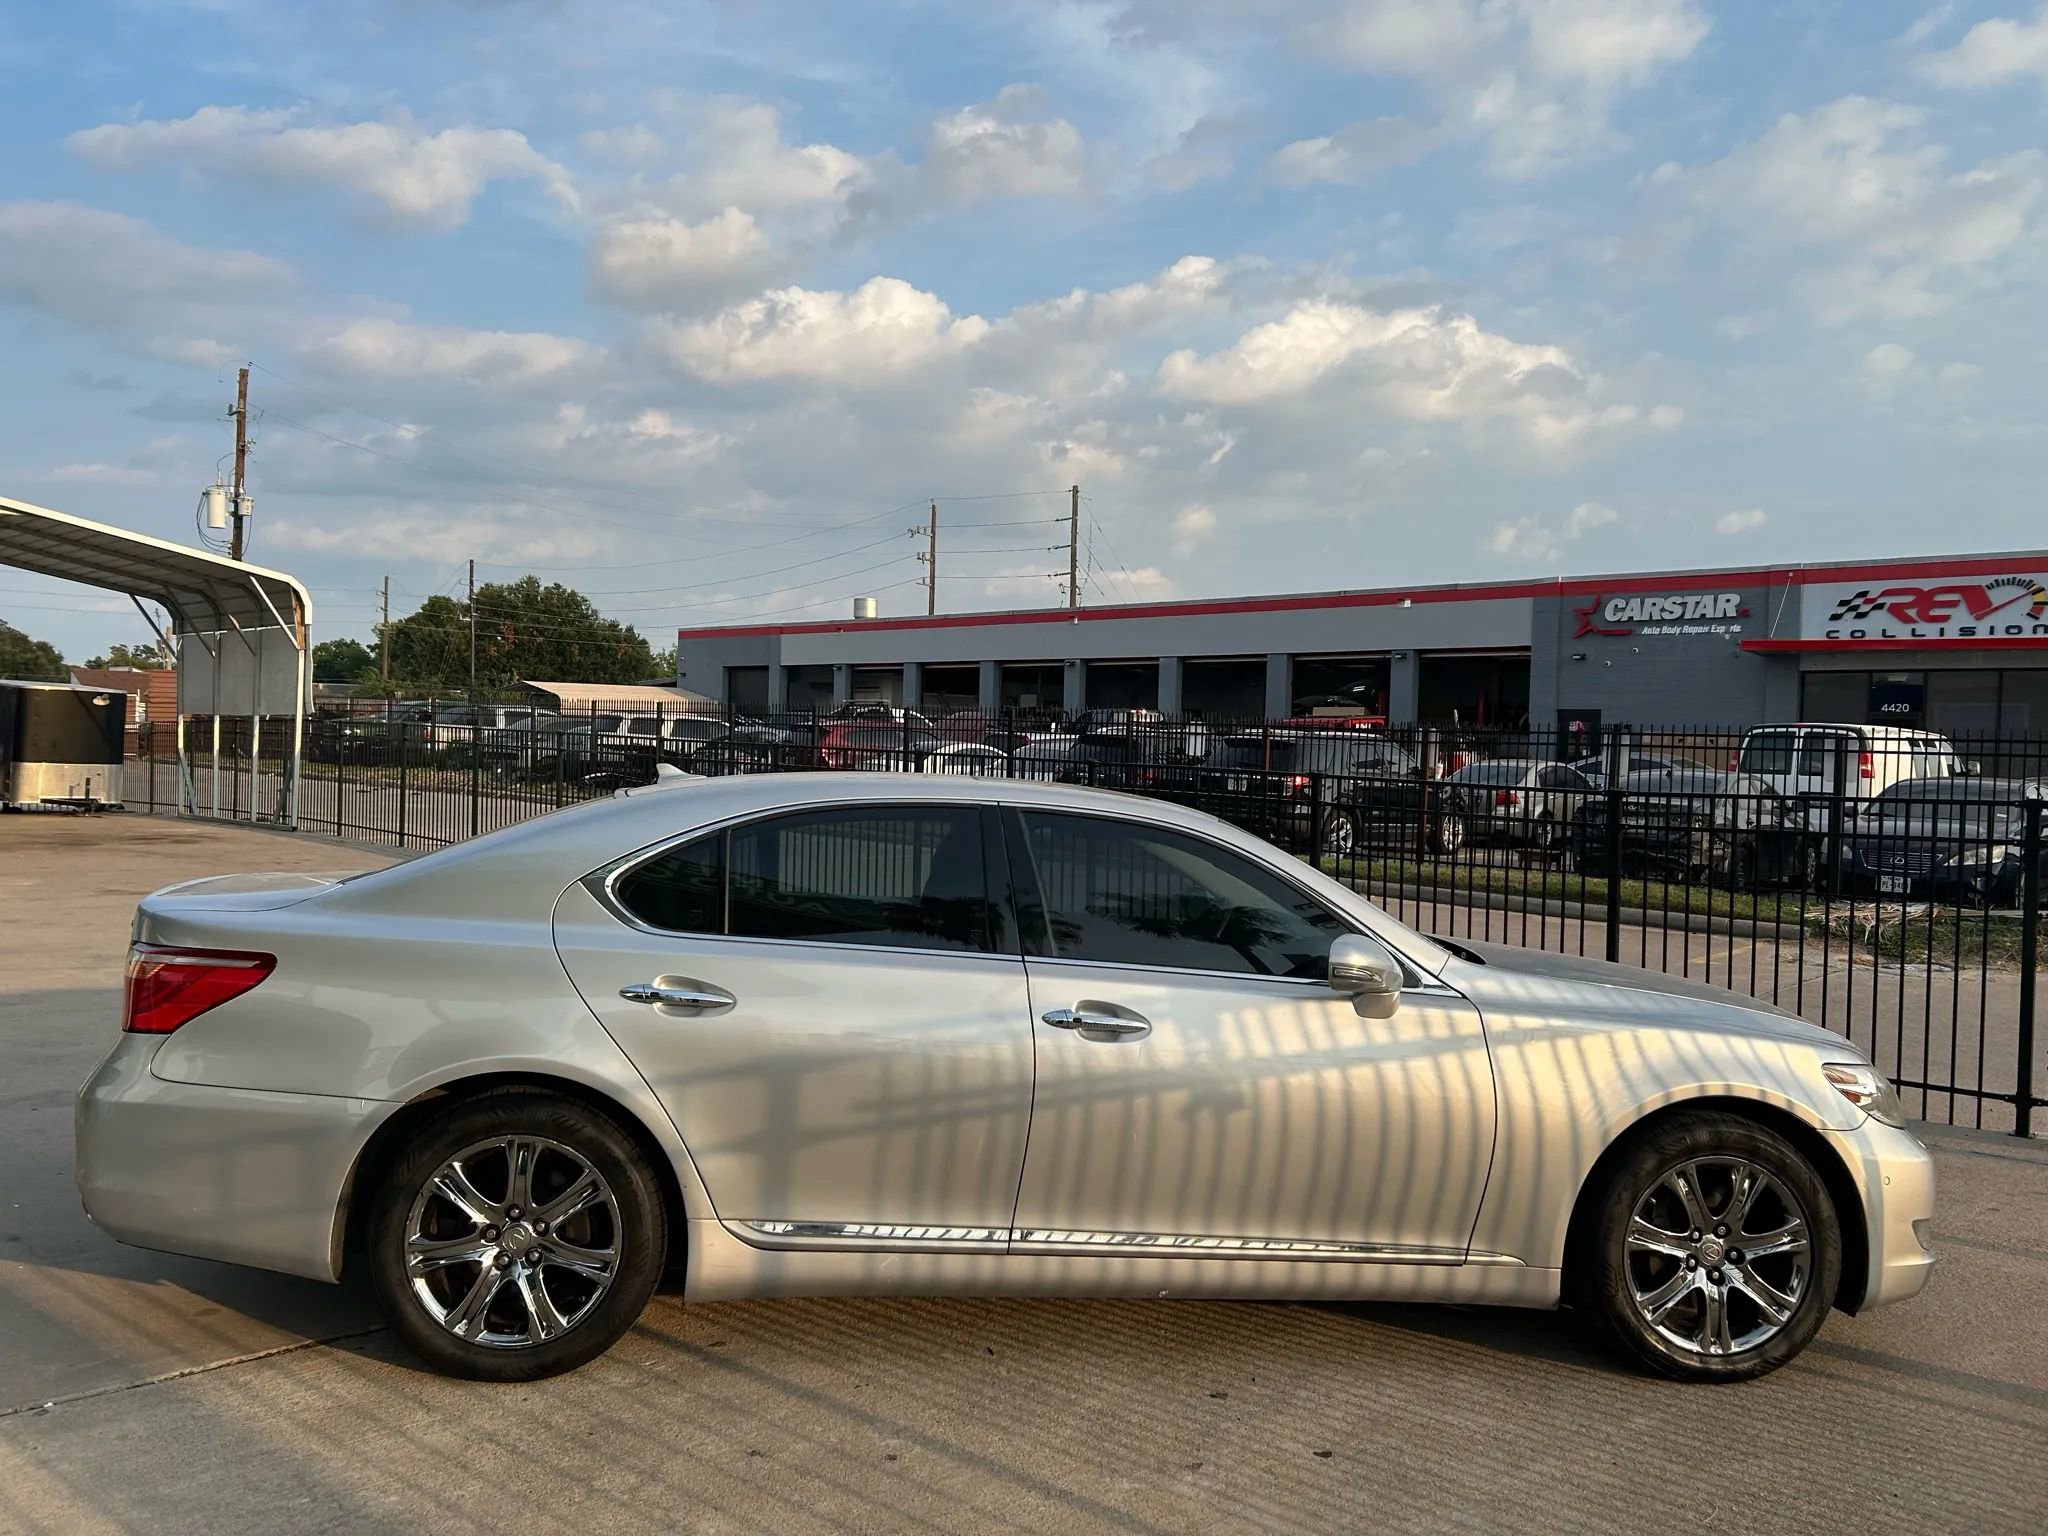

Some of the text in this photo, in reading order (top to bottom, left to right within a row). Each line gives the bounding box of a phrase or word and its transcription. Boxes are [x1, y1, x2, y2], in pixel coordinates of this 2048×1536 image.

[1604, 594, 1740, 622] CARSTAR
[1863, 584, 2028, 625] REV
[1641, 624, 1742, 636] Auto Body Repair Exprts
[1825, 624, 2048, 640] COLLISION
[1881, 703, 1910, 713] 4420
